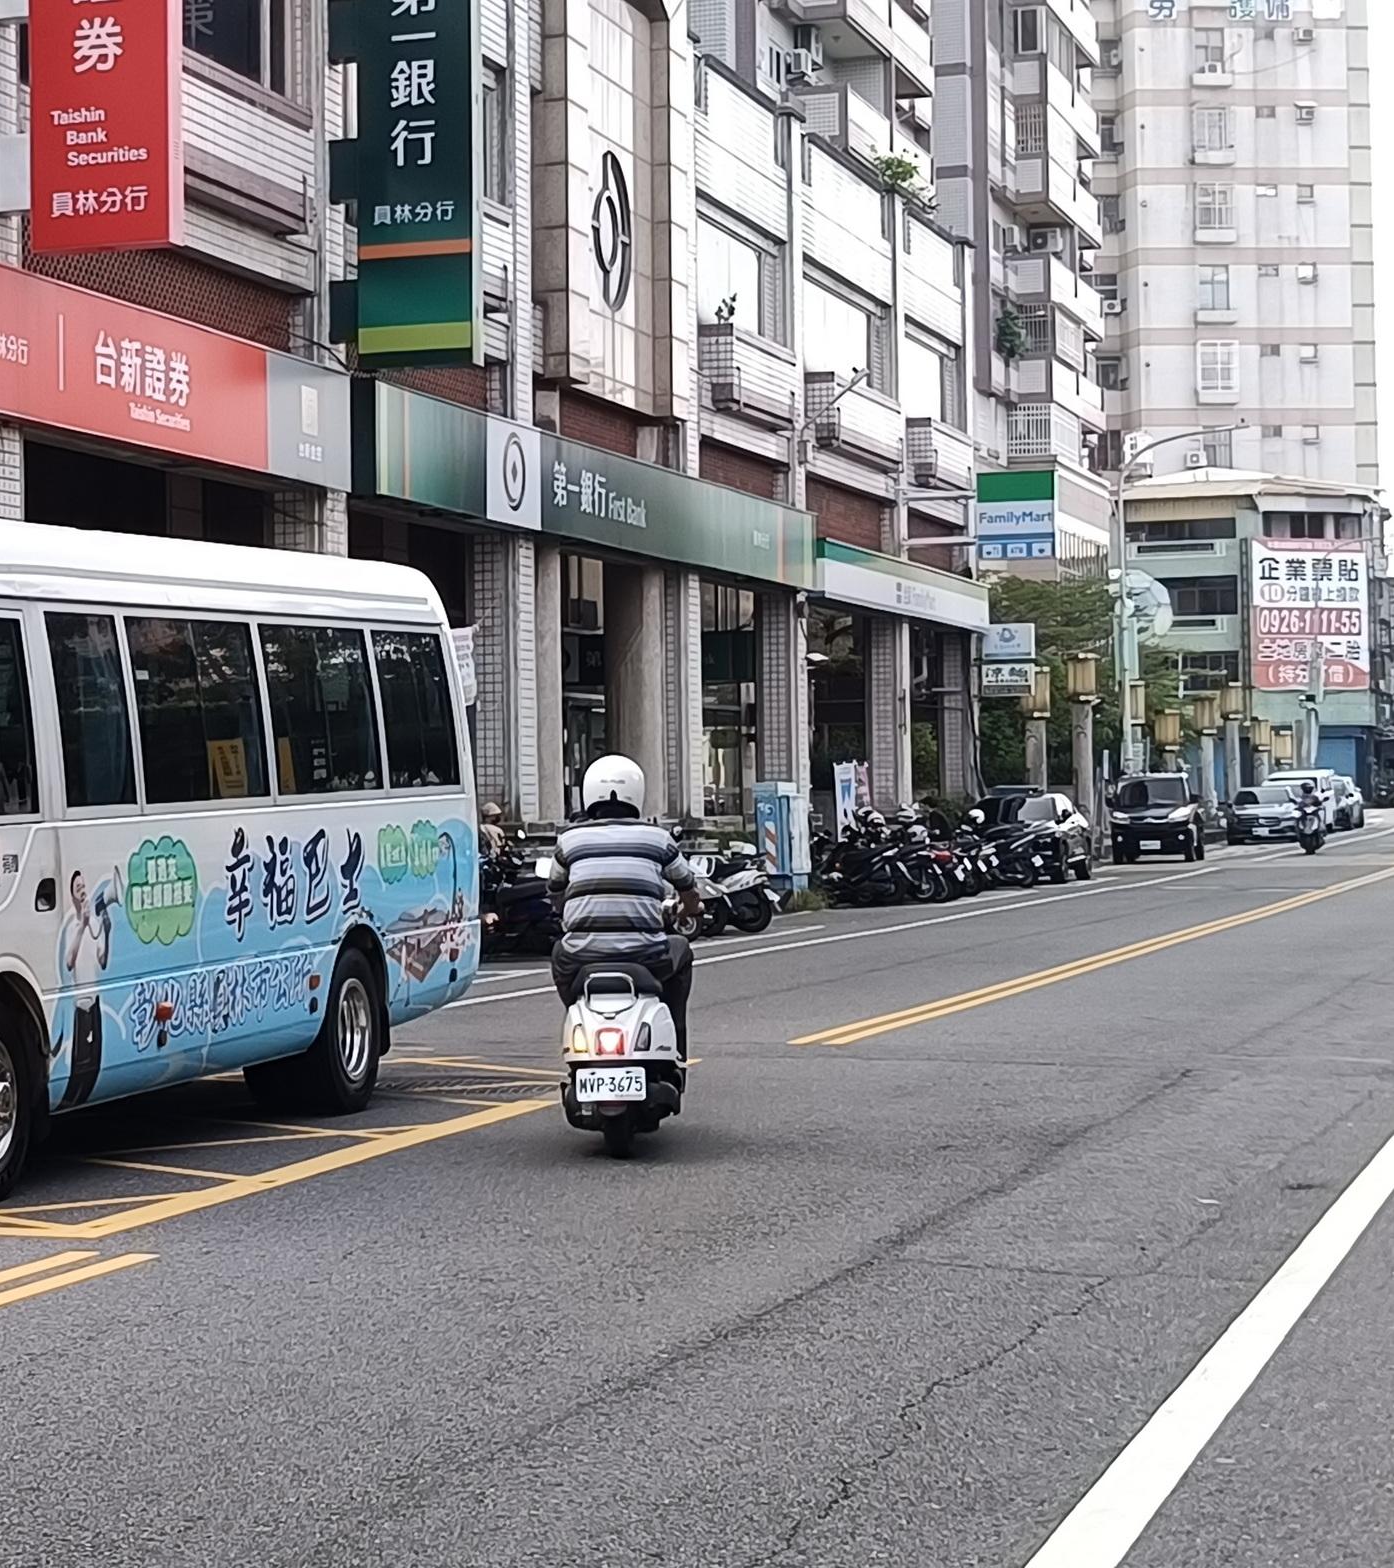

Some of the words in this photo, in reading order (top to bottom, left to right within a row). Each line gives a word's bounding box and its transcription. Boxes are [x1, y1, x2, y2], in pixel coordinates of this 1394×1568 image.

[50, 107, 106, 126] Taishin
[66, 128, 108, 145] Bank
[67, 146, 148, 167] Securities
[50, 185, 148, 218] 員林分行
[373, 200, 455, 226] 員林分行
[94, 330, 191, 407] 台新證券
[553, 460, 607, 518] 第一銀行
[608, 491, 625, 522] First
[626, 497, 647, 528] Bank
[979, 511, 1053, 526] FamilyMart
[1258, 557, 1359, 581] 企業票貼
[225, 826, 366, 942] 幸福巴士
